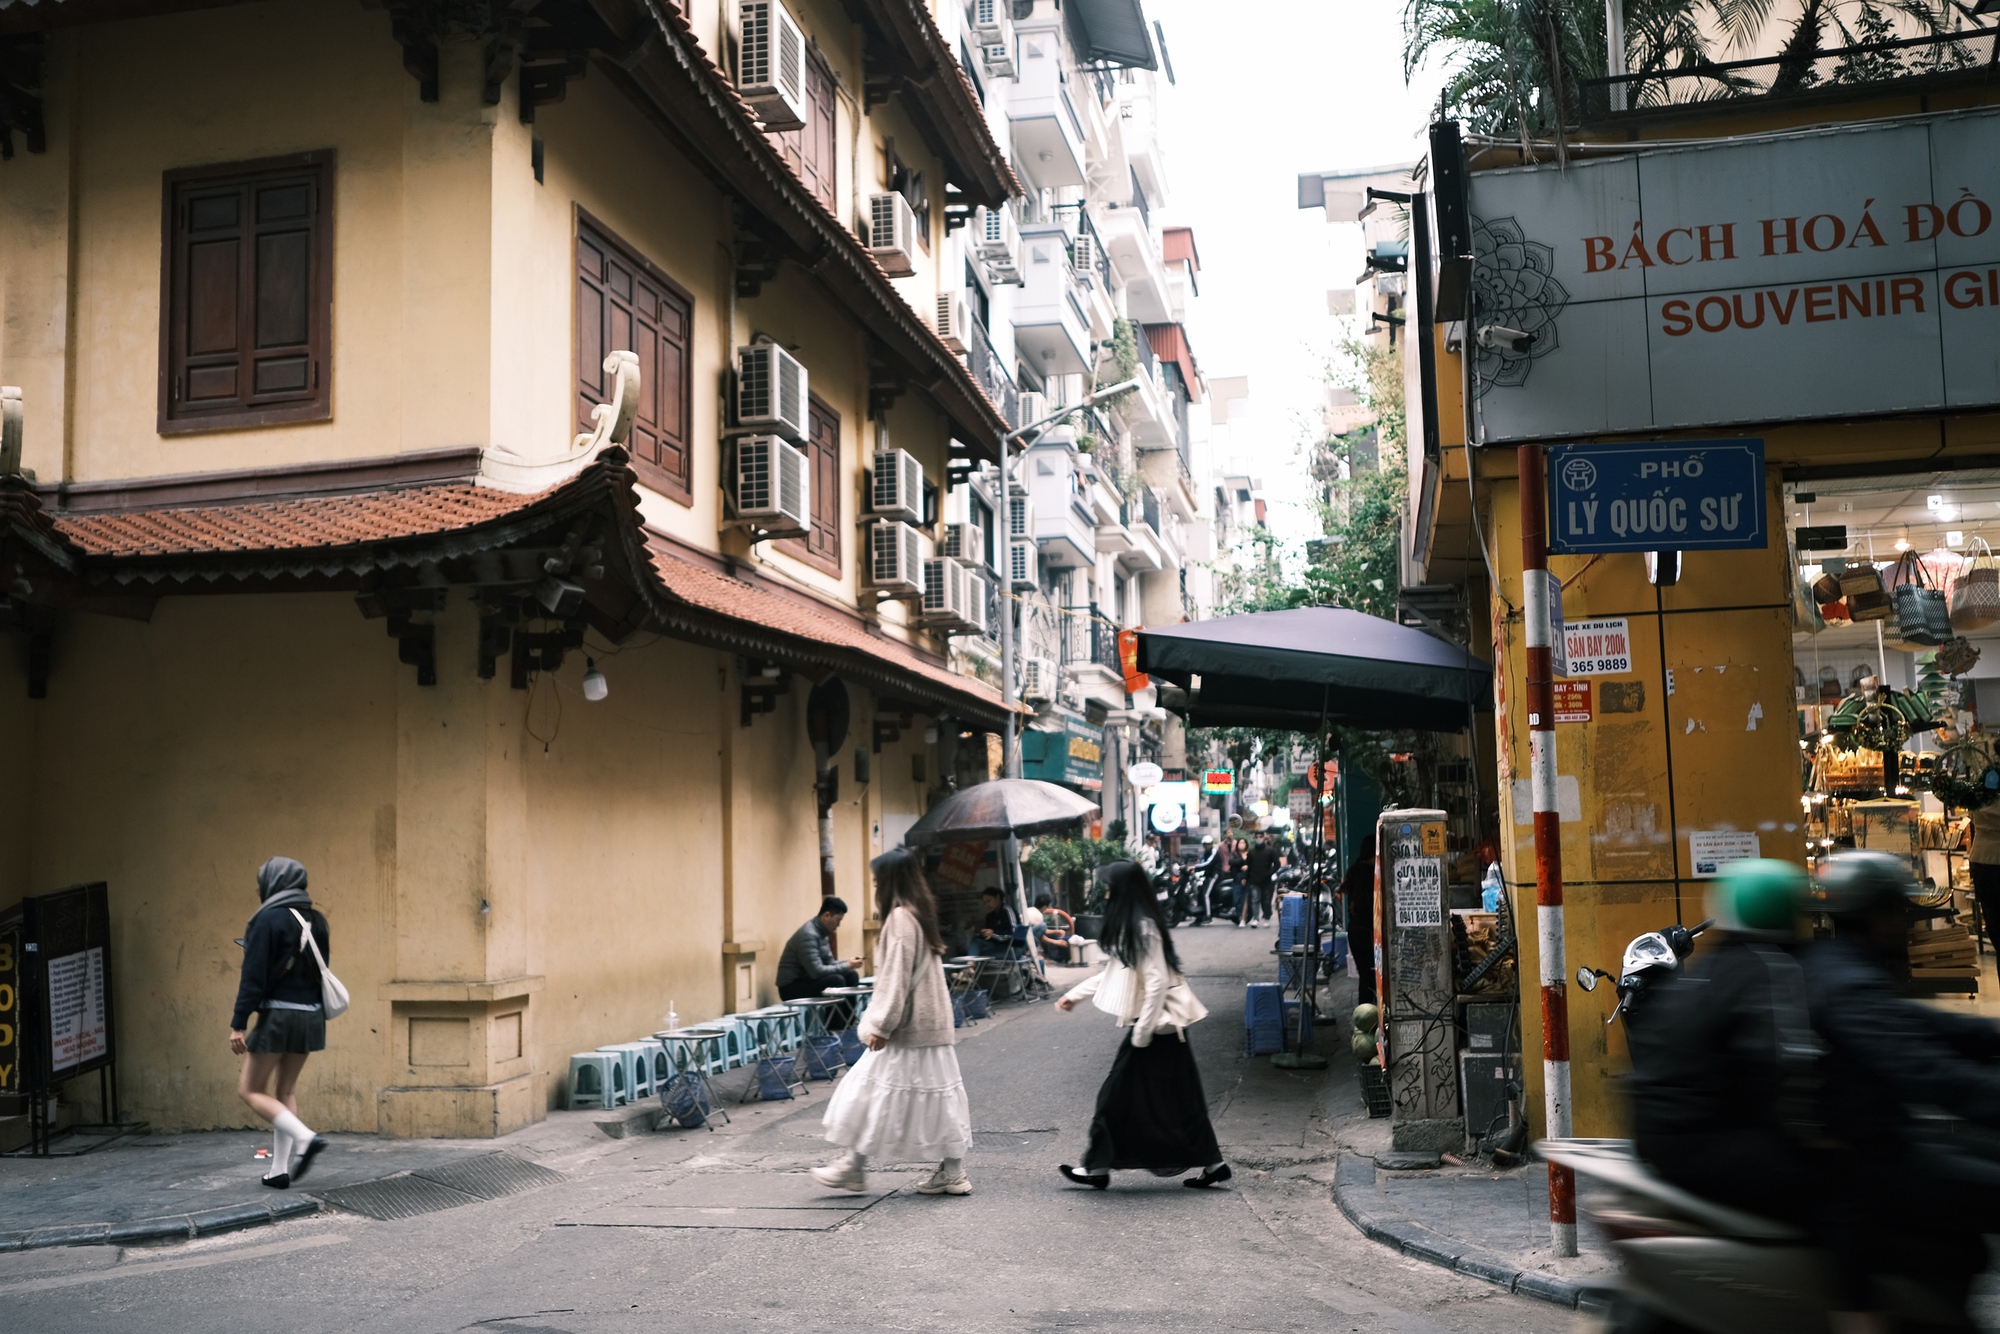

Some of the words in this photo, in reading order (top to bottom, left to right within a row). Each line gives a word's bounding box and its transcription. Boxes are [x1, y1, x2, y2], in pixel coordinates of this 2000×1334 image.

[1580, 220, 1739, 274] BÁCH
[1757, 198, 1890, 257] HOÁ
[1901, 186, 1992, 243] ĐỒ
[1661, 277, 1926, 337] SOUVENIR
[1640, 452, 1708, 479] PHỐ
[1568, 492, 1598, 535] LÝ
[1610, 486, 1688, 538] QUỐC
[1700, 492, 1743, 531] SƯ
[1568, 632, 1586, 658] SÂN
[1587, 634, 1602, 657] BAY
[1605, 633, 1626, 656] 200k
[1572, 660, 1594, 673] 365
[1597, 658, 1627, 671] 9889
[1554, 684, 1567, 692] BAY
